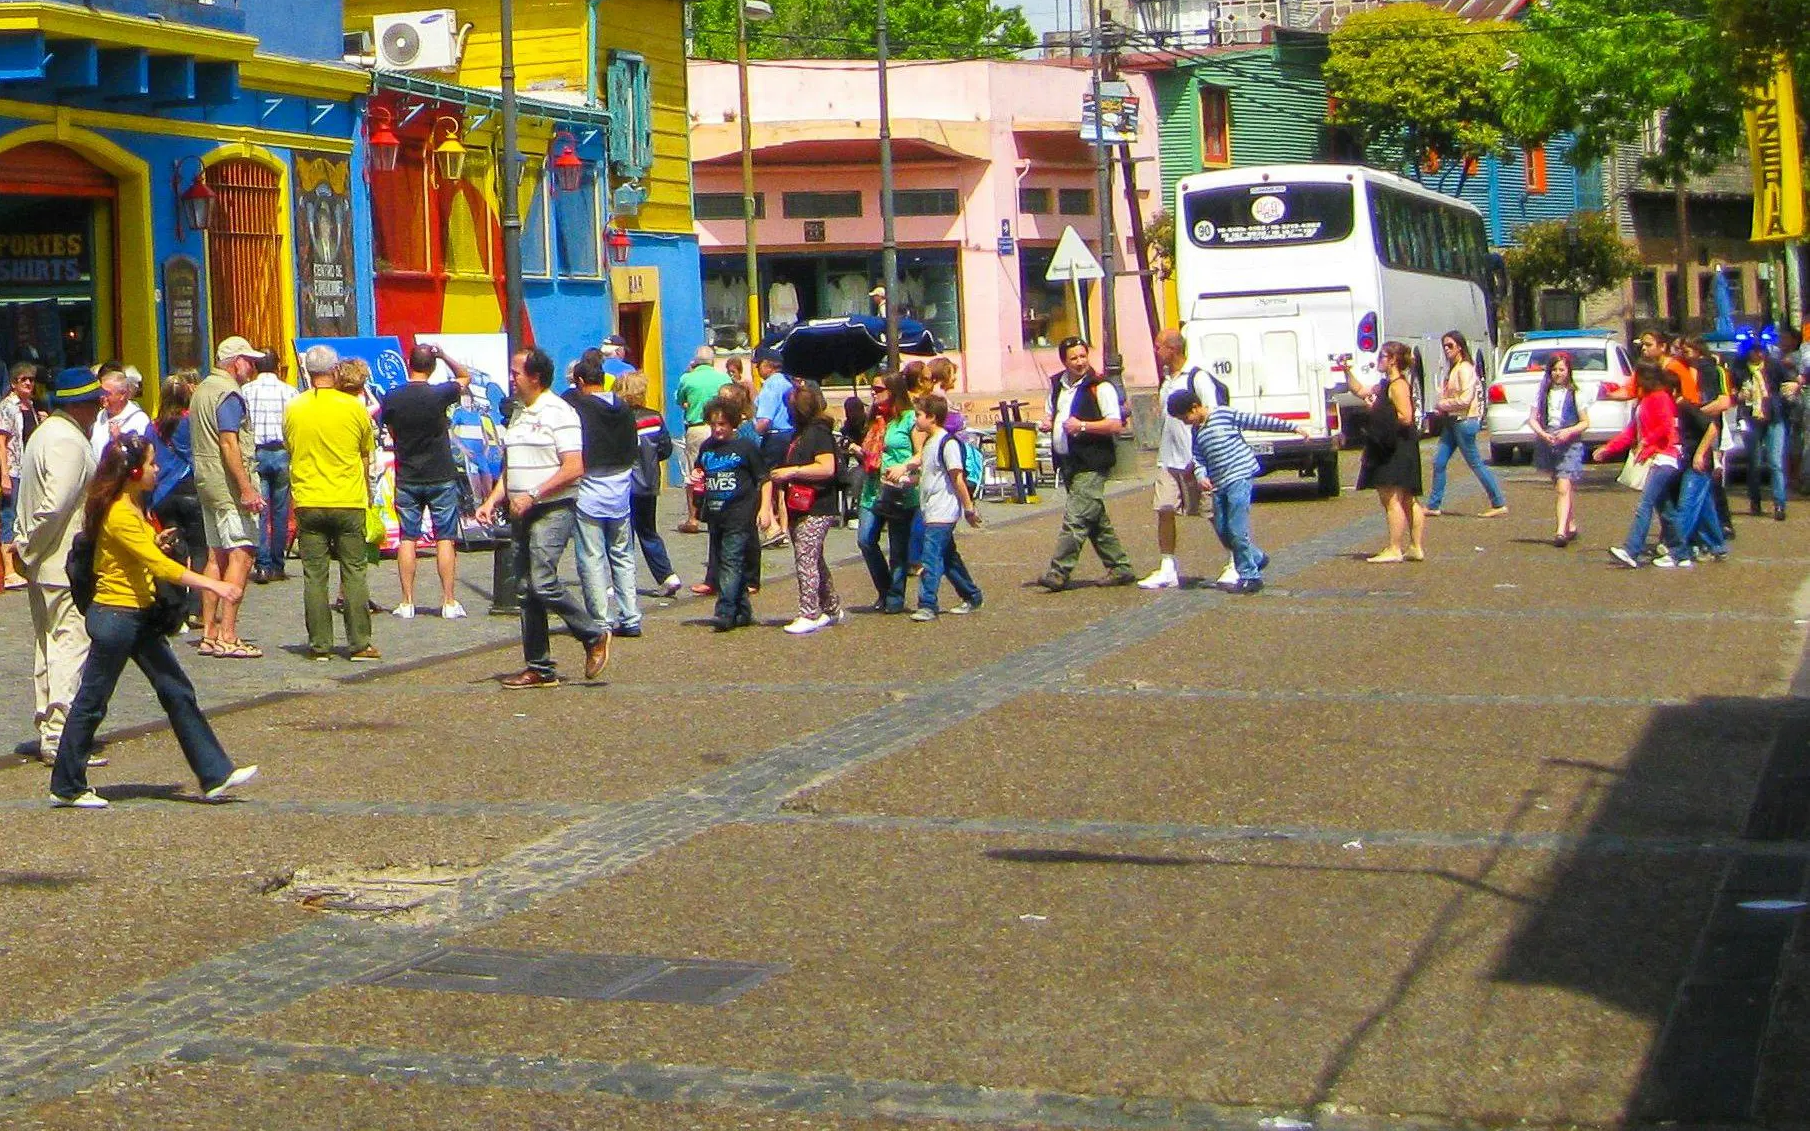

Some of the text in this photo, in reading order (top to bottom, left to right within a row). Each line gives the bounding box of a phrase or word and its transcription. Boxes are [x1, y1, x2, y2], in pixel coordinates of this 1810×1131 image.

[1756, 74, 1787, 235] IZZERIA
[1198, 224, 1211, 238] 90
[1213, 361, 1233, 375] 110
[705, 477, 737, 491] AVES
